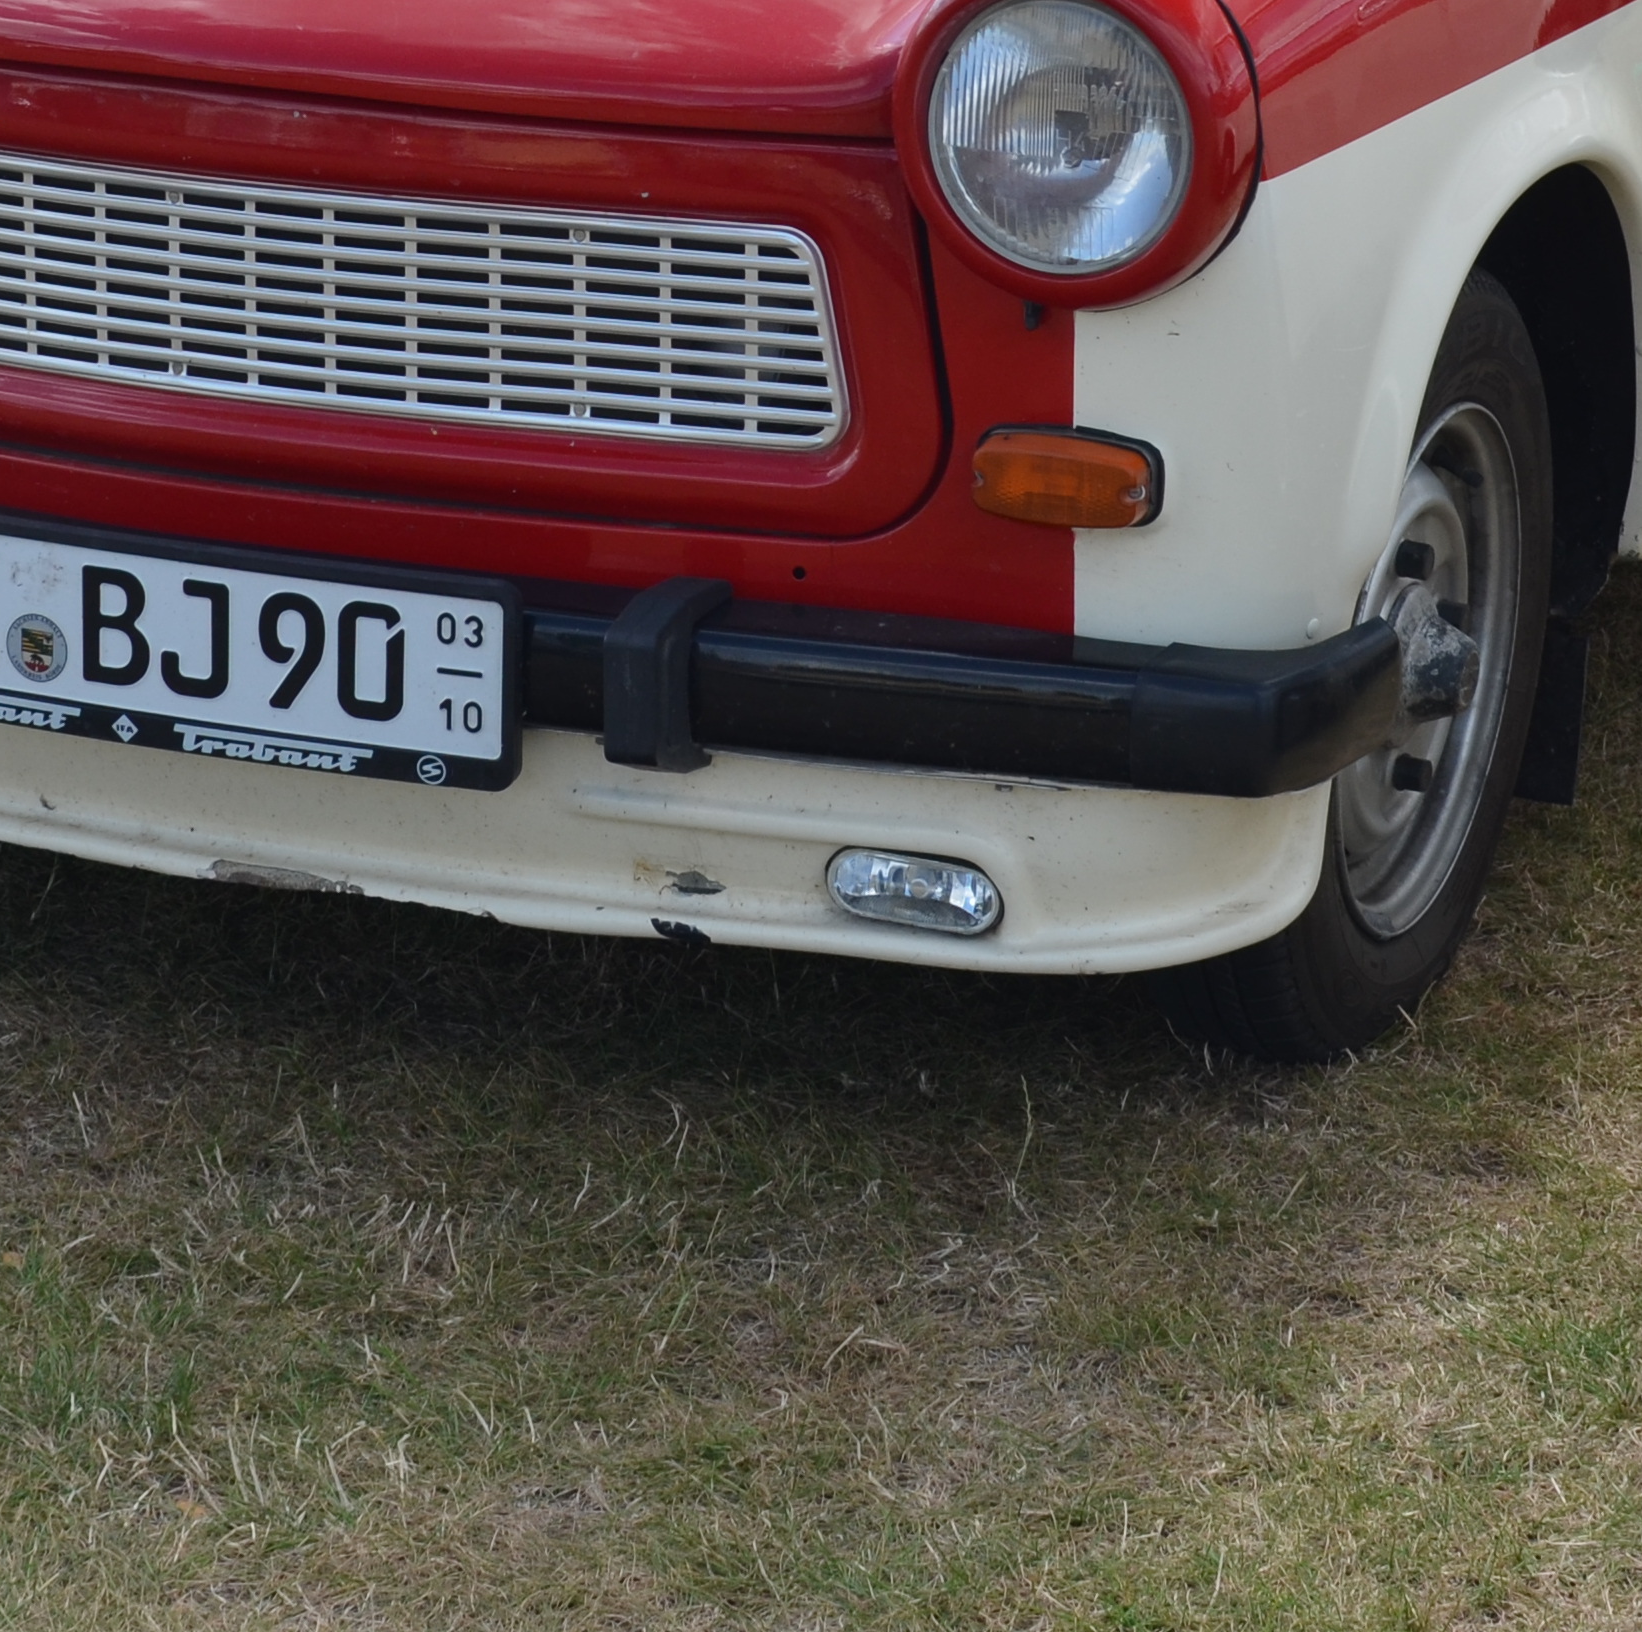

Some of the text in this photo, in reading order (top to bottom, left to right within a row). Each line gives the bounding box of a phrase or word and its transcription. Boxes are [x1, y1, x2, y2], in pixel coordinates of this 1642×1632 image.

[436, 612, 485, 648] 03
[439, 697, 485, 734] 10
[115, 723, 135, 734] IFA
[174, 723, 374, 773] Trabant
